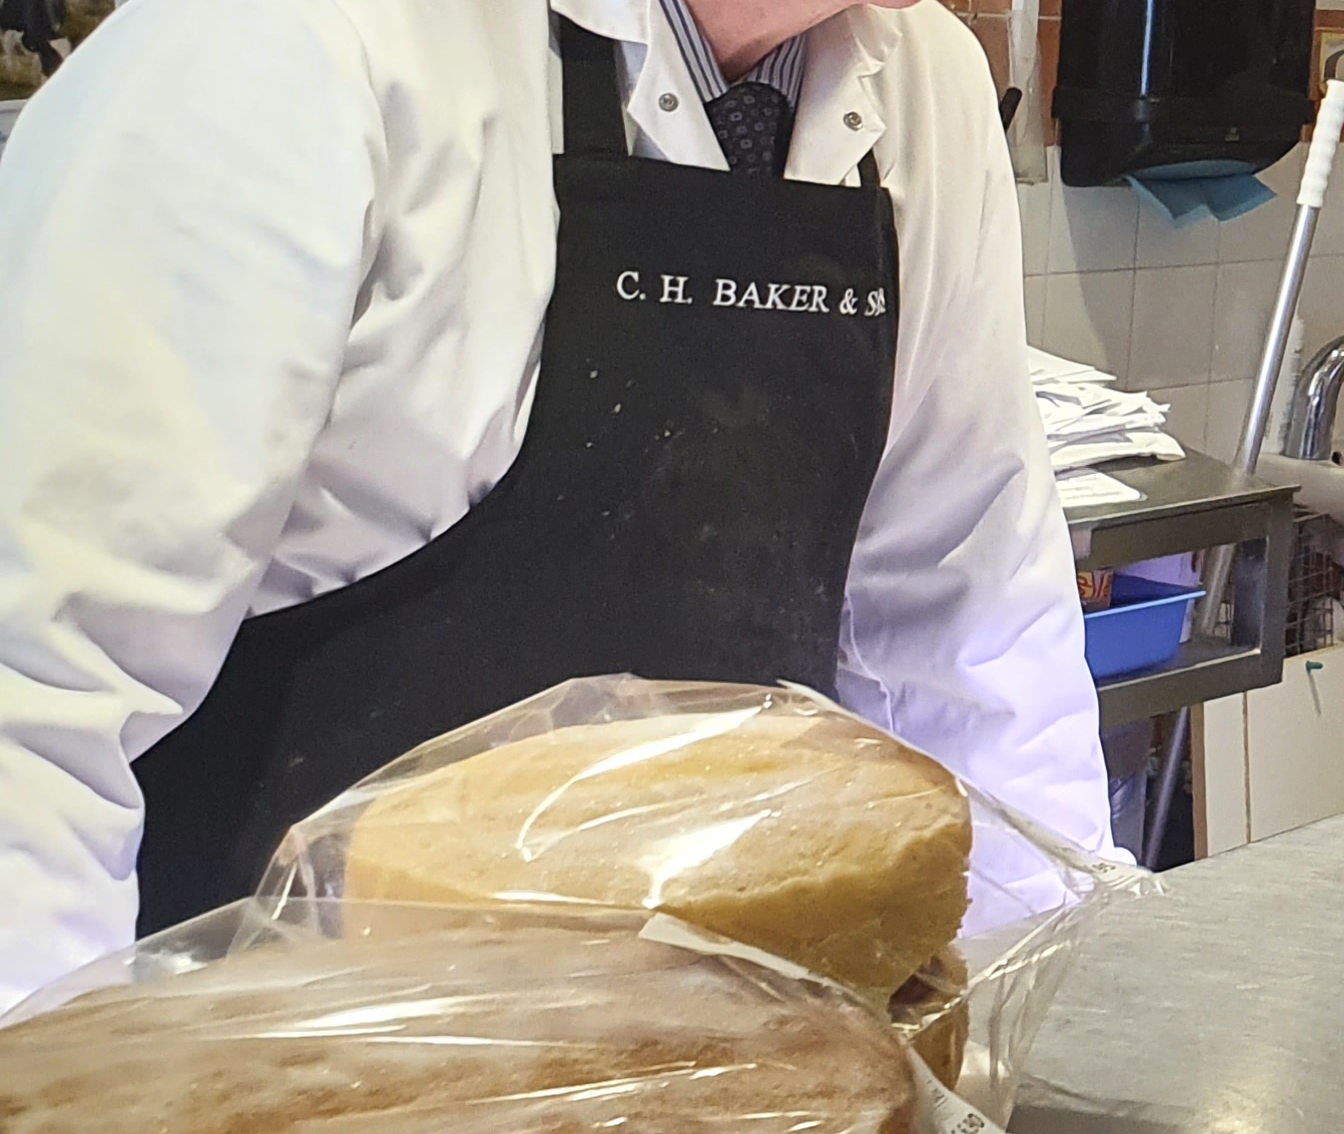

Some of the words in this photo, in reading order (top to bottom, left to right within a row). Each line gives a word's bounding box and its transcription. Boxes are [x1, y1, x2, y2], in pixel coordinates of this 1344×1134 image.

[616, 270, 646, 300] C.
[659, 274, 692, 304] H.
[713, 278, 829, 312] BAKER
[839, 288, 857, 314] &
